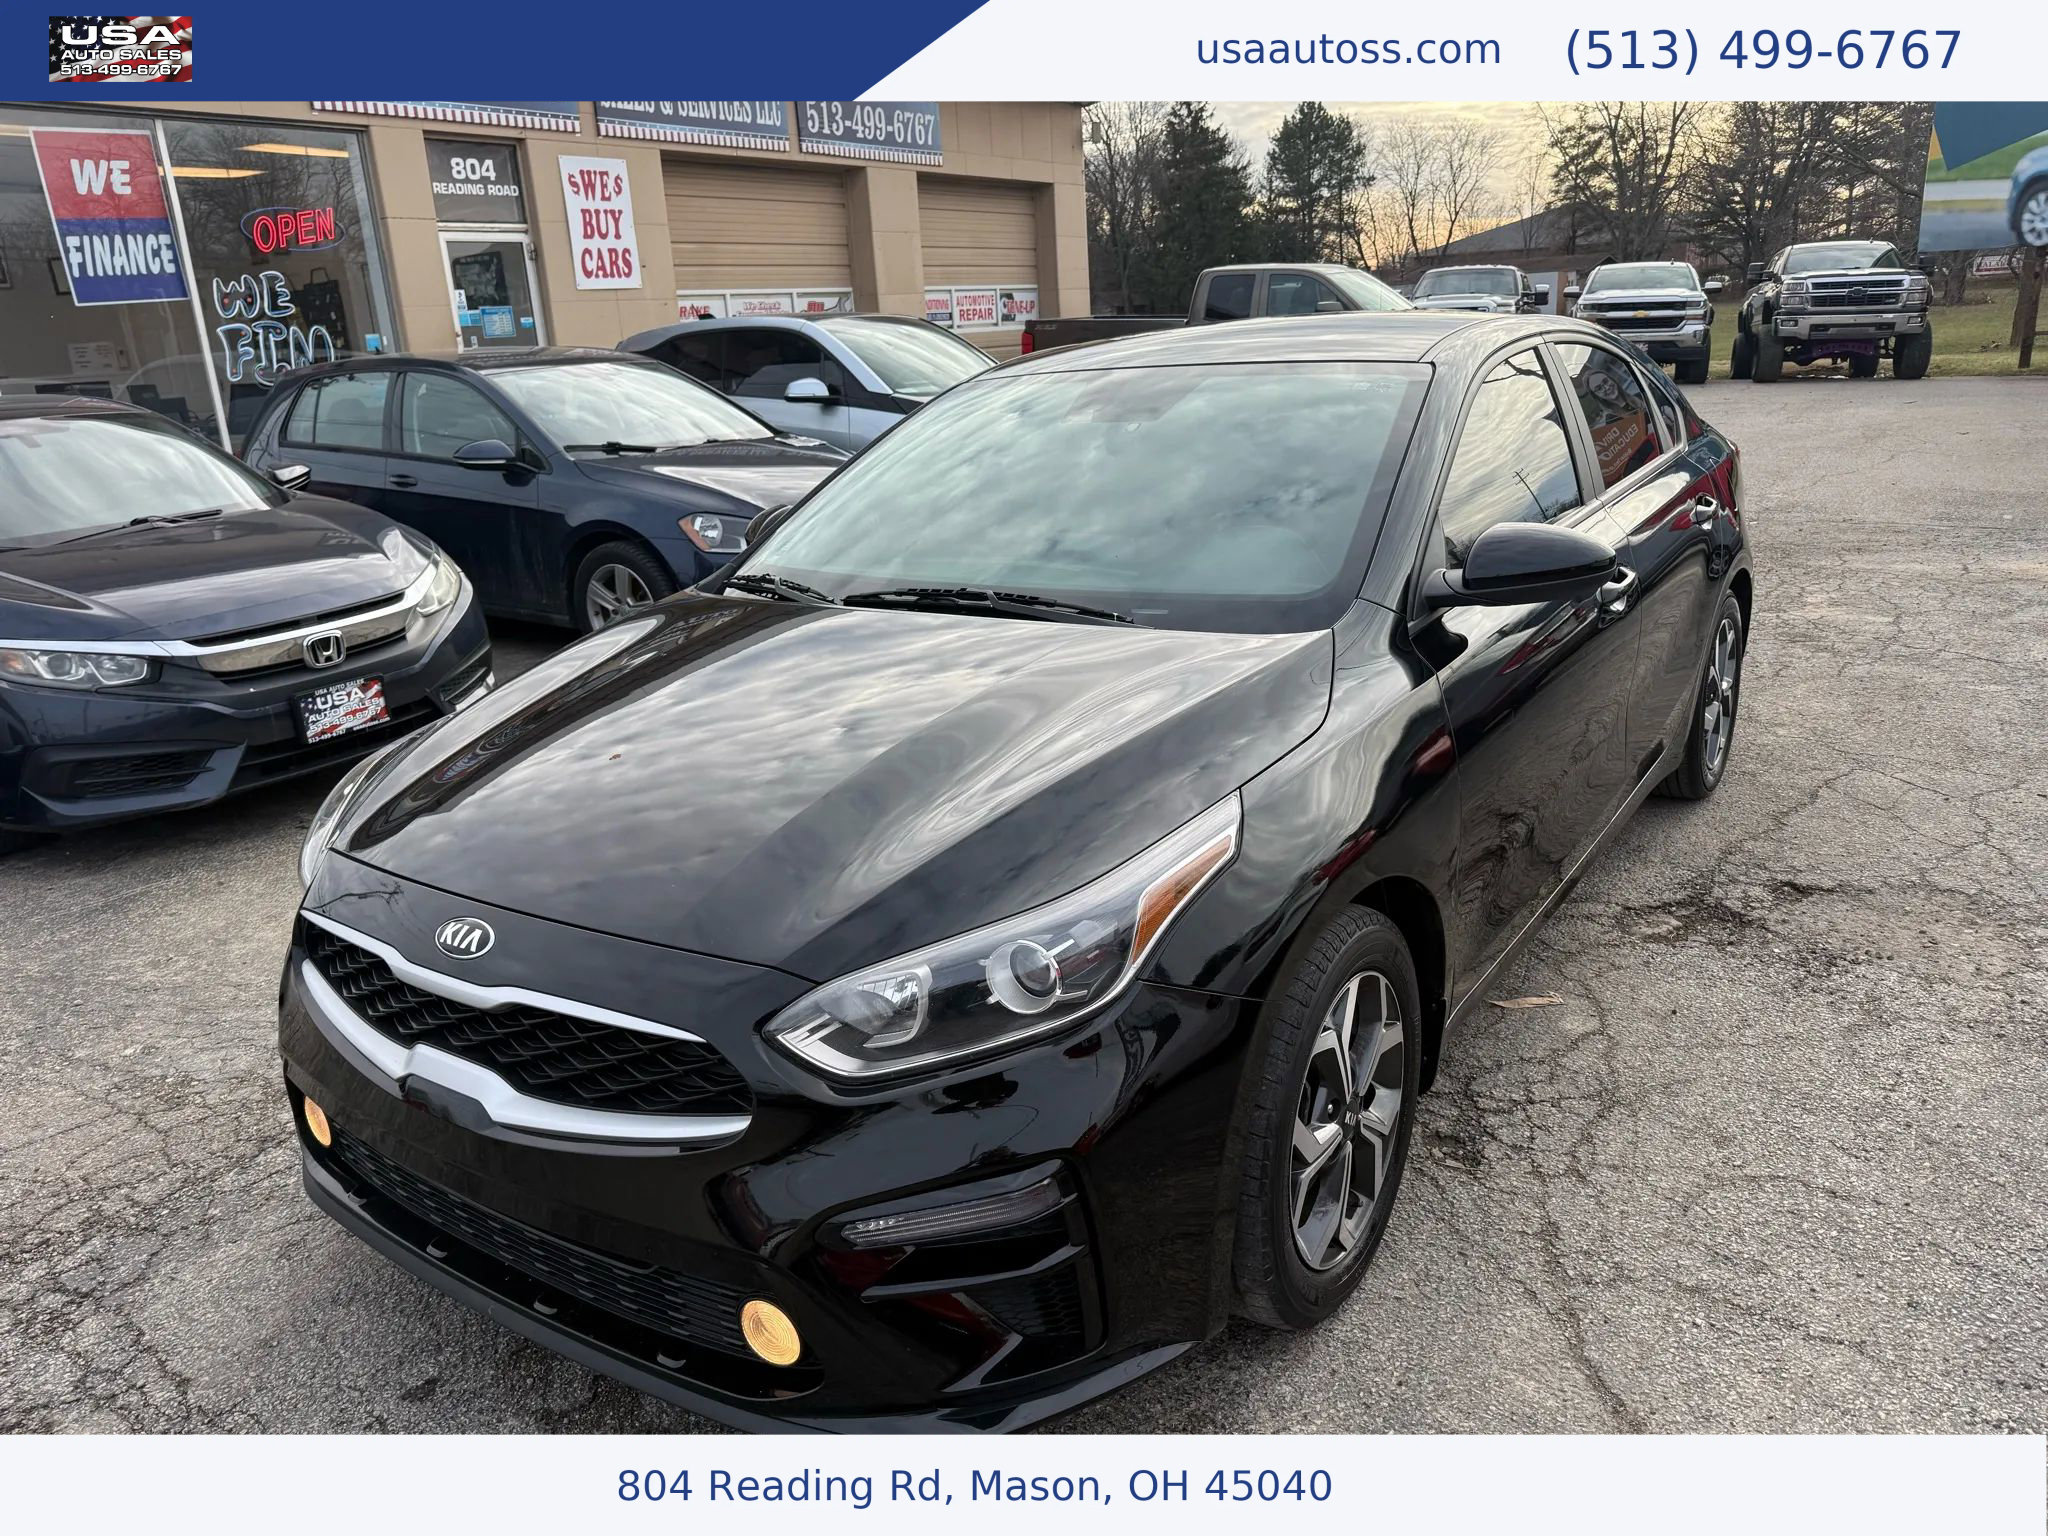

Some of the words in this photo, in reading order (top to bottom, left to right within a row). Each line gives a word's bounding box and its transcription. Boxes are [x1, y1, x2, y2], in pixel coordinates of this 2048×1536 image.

[756, 101, 781, 127] LLC
[806, 101, 936, 147] 513-499-6767
[70, 158, 132, 195] WE
[450, 157, 497, 181] 804
[433, 181, 485, 196] READING
[488, 183, 519, 197] ROAD
[252, 207, 335, 253] OPEN
[580, 209, 623, 240] BUY
[66, 233, 176, 278] FINANCE
[580, 247, 633, 279] CARS
[213, 271, 295, 318] WE
[956, 295, 994, 306] AUTOMOTIVE
[679, 305, 711, 318] RAKE
[959, 307, 994, 320] REPAIR
[316, 687, 365, 709] USA
[329, 684, 345, 692] AUTO
[347, 678, 365, 687] SALES
[308, 708, 340, 723] AUTO
[341, 697, 380, 713] SALES
[309, 706, 382, 732] 513-499-6767
[440, 922, 483, 952] KIA
